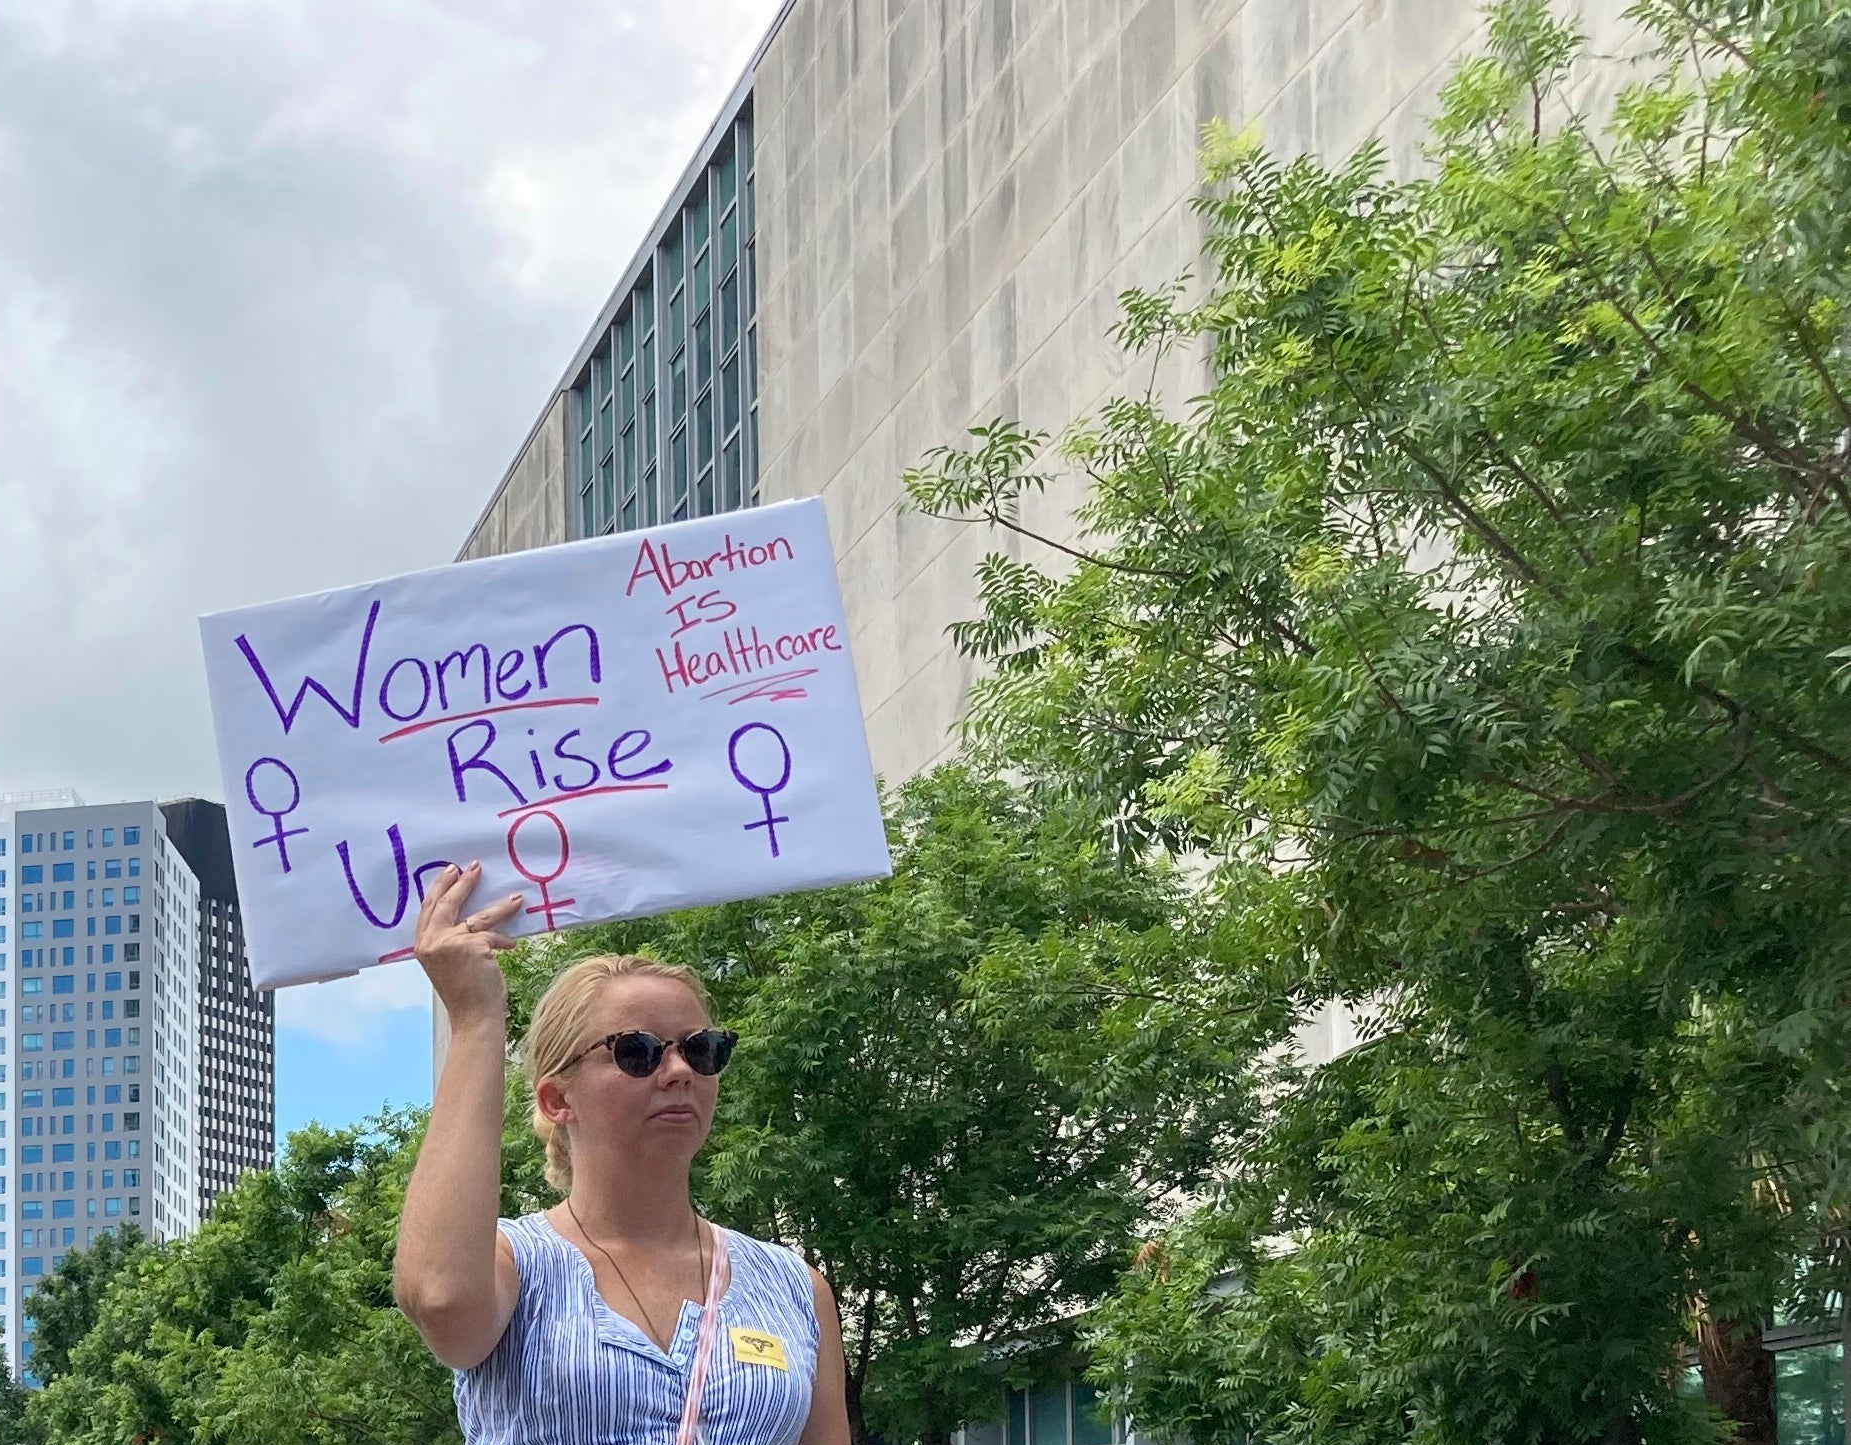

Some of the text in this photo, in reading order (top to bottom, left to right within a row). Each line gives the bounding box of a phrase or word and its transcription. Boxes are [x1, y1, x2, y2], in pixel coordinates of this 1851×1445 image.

[625, 534, 795, 597] Abortion
[664, 590, 737, 638] IS
[234, 600, 602, 736] Women
[656, 621, 843, 693] Healthcare
[447, 718, 674, 805] Rise
